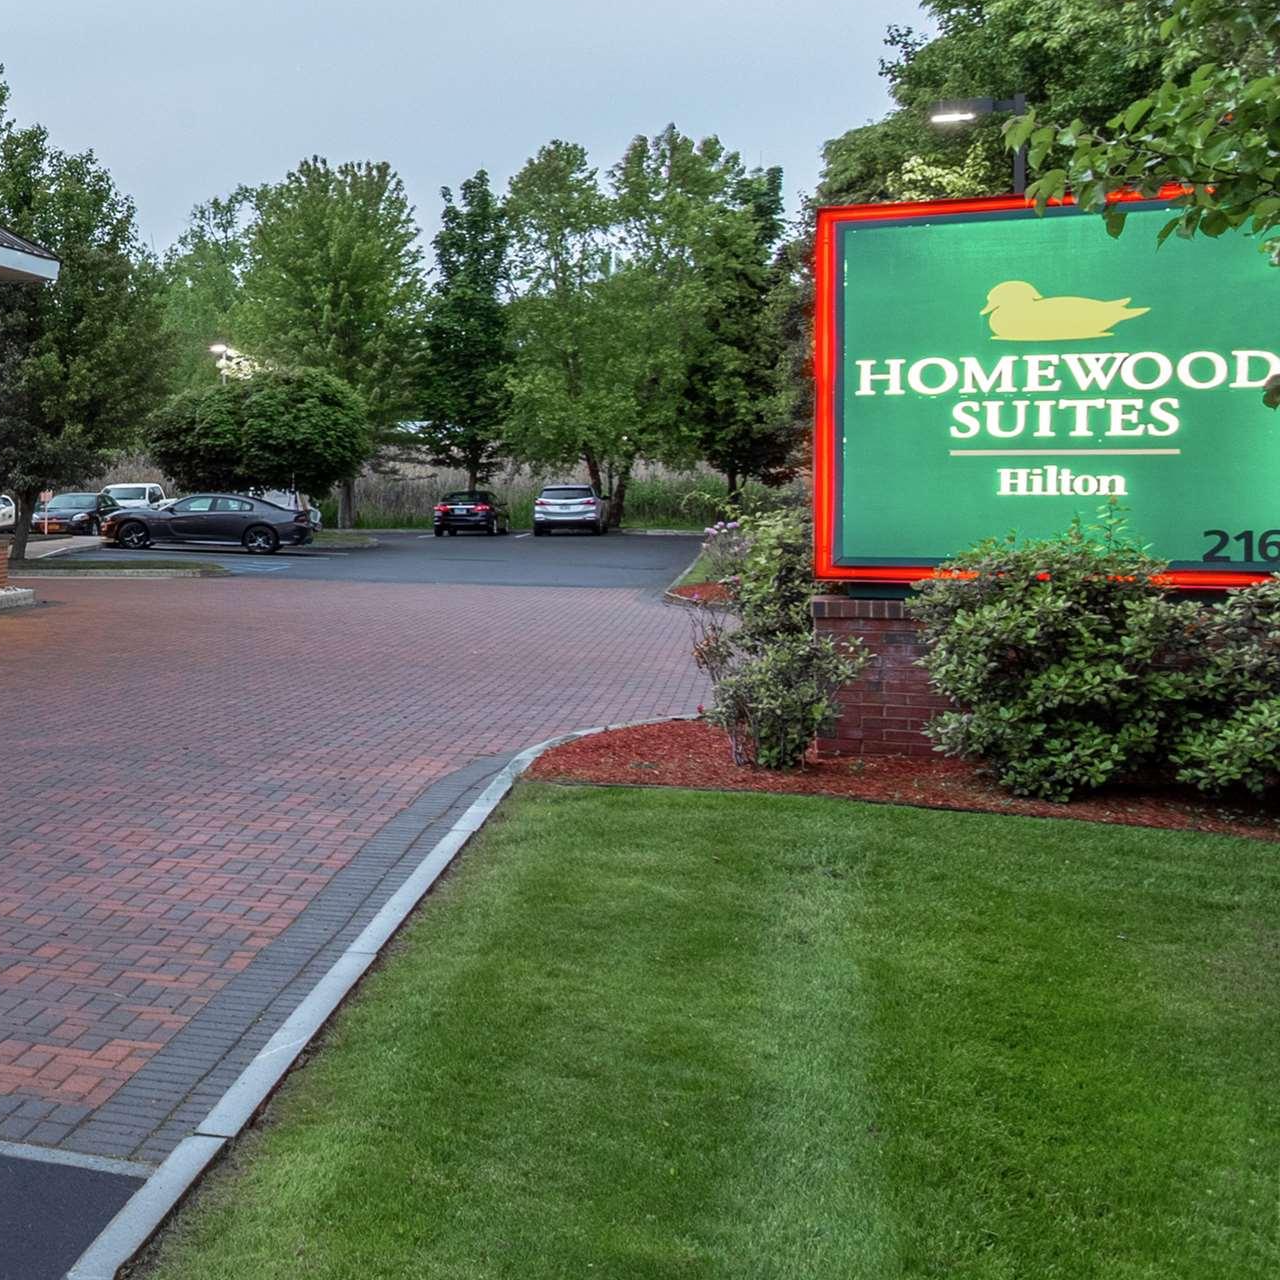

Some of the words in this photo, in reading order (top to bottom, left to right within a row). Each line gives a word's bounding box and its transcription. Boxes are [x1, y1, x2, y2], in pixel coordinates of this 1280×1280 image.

[854, 349, 1280, 397] HOMEWOOD
[949, 397, 1181, 439] SUITES
[996, 465, 1128, 497] Hilton
